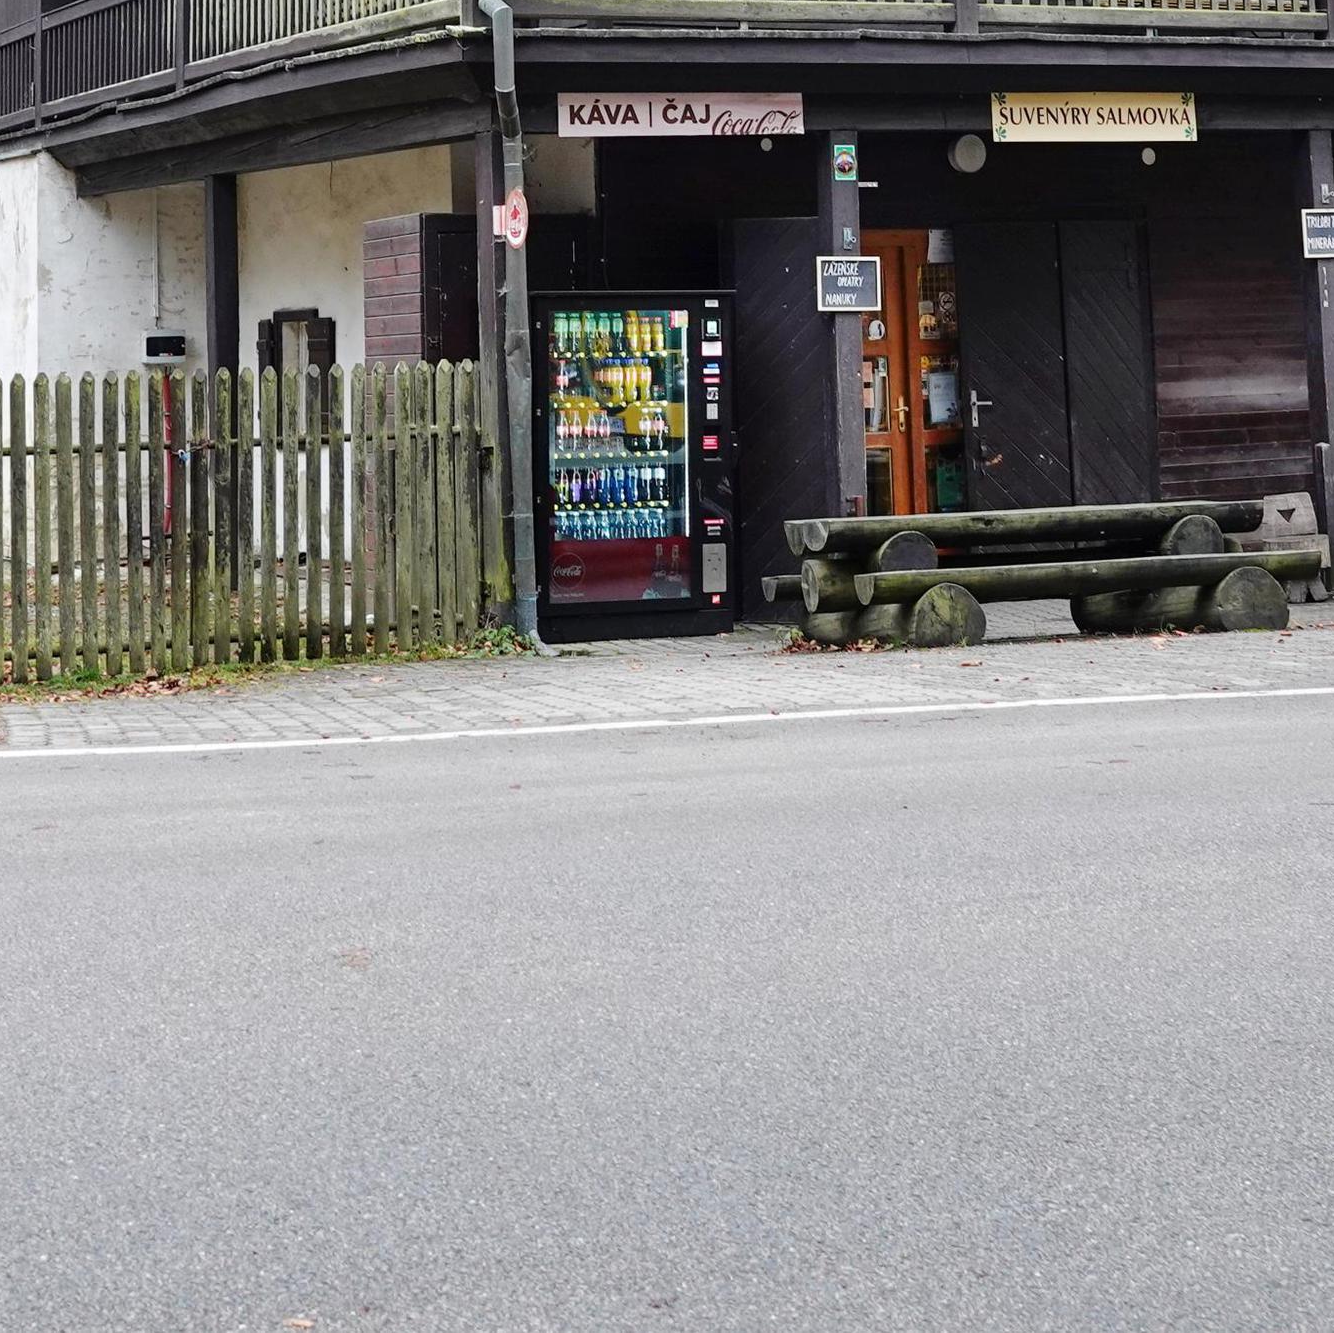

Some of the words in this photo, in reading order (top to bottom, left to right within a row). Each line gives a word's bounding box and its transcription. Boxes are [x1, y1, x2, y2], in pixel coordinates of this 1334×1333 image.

[569, 98, 640, 125] KÁVA
[662, 98, 711, 124] ČAJ
[999, 101, 1091, 125] SUVENÝRY
[1097, 107, 1191, 125] SALMOVKA
